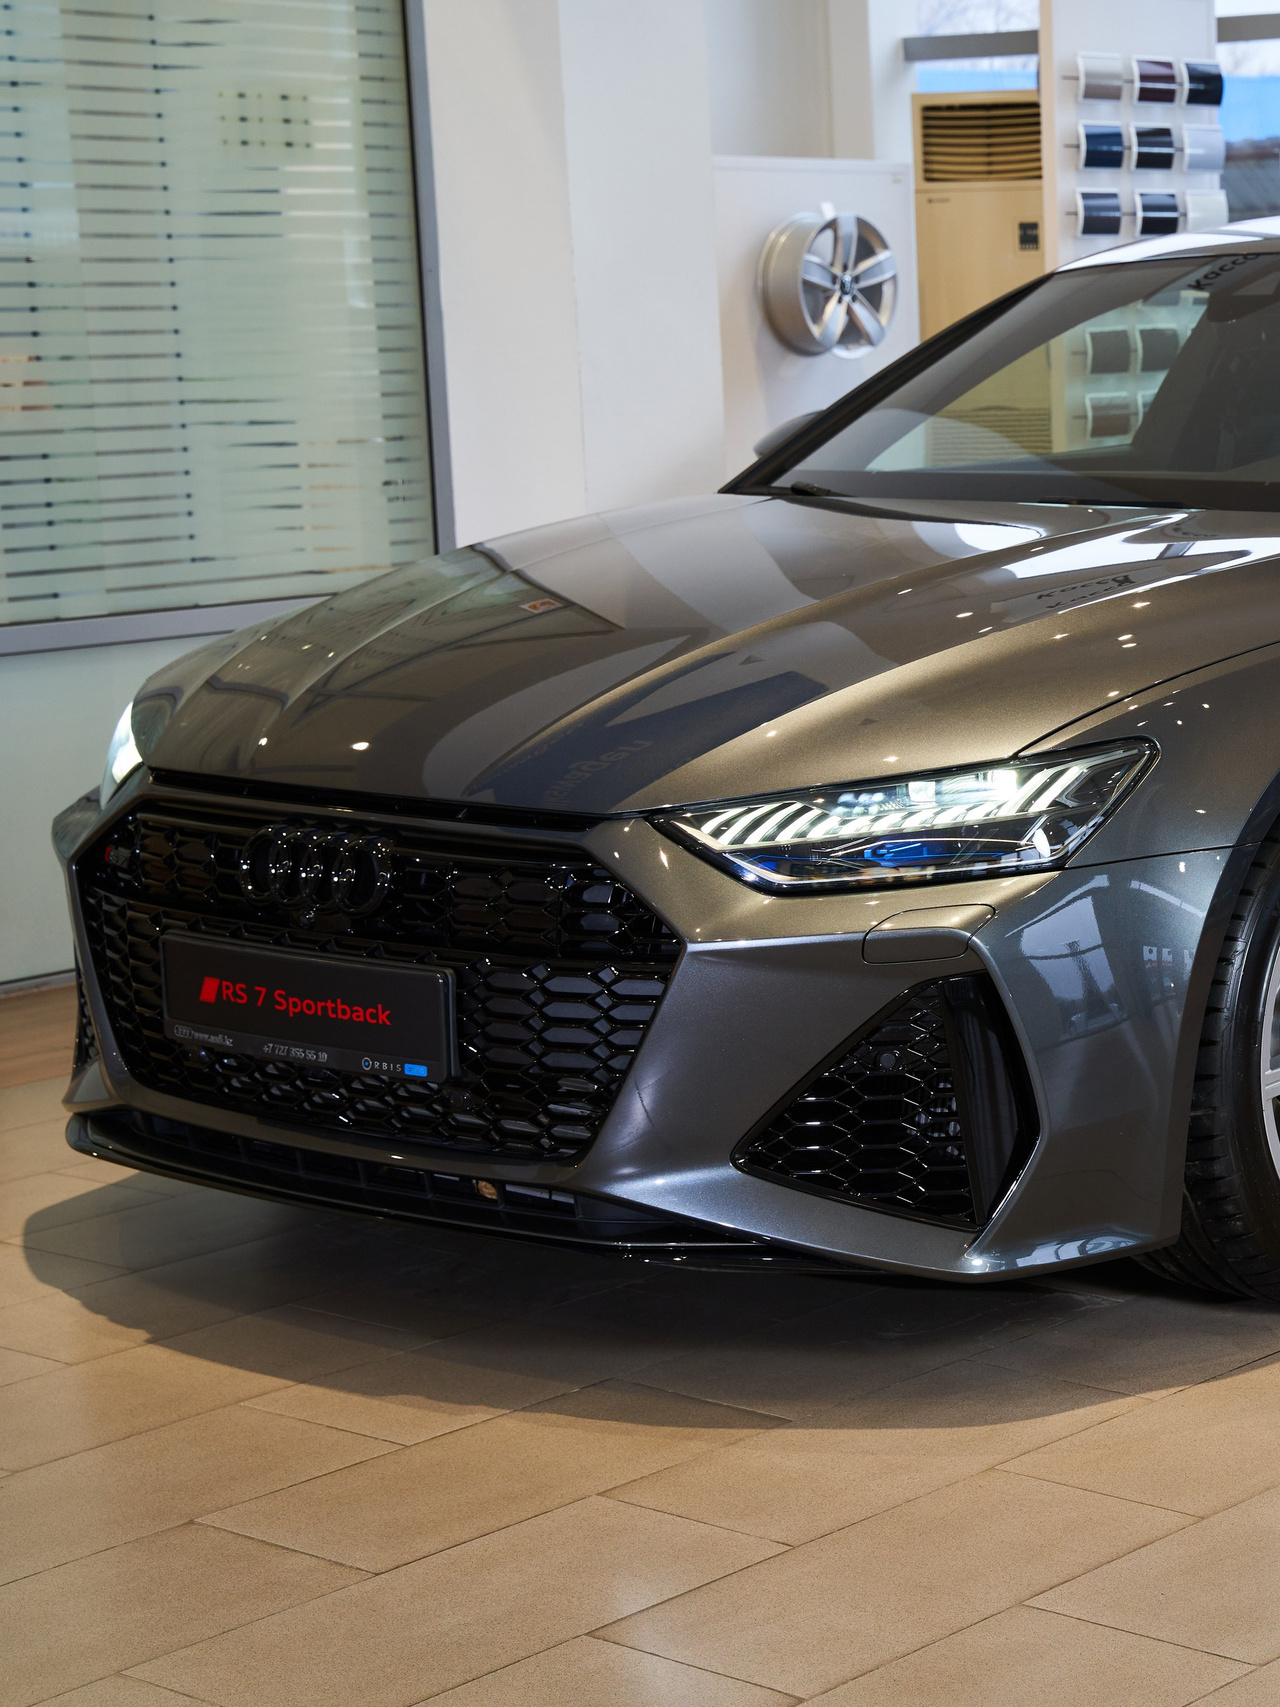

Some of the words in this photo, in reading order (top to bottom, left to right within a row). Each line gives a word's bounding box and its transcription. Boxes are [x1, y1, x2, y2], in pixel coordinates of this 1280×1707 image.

[221, 980, 248, 1004] RS
[254, 986, 267, 1006] 7
[273, 989, 391, 1026] Sportback
[361, 1057, 402, 1072] ORBIS
